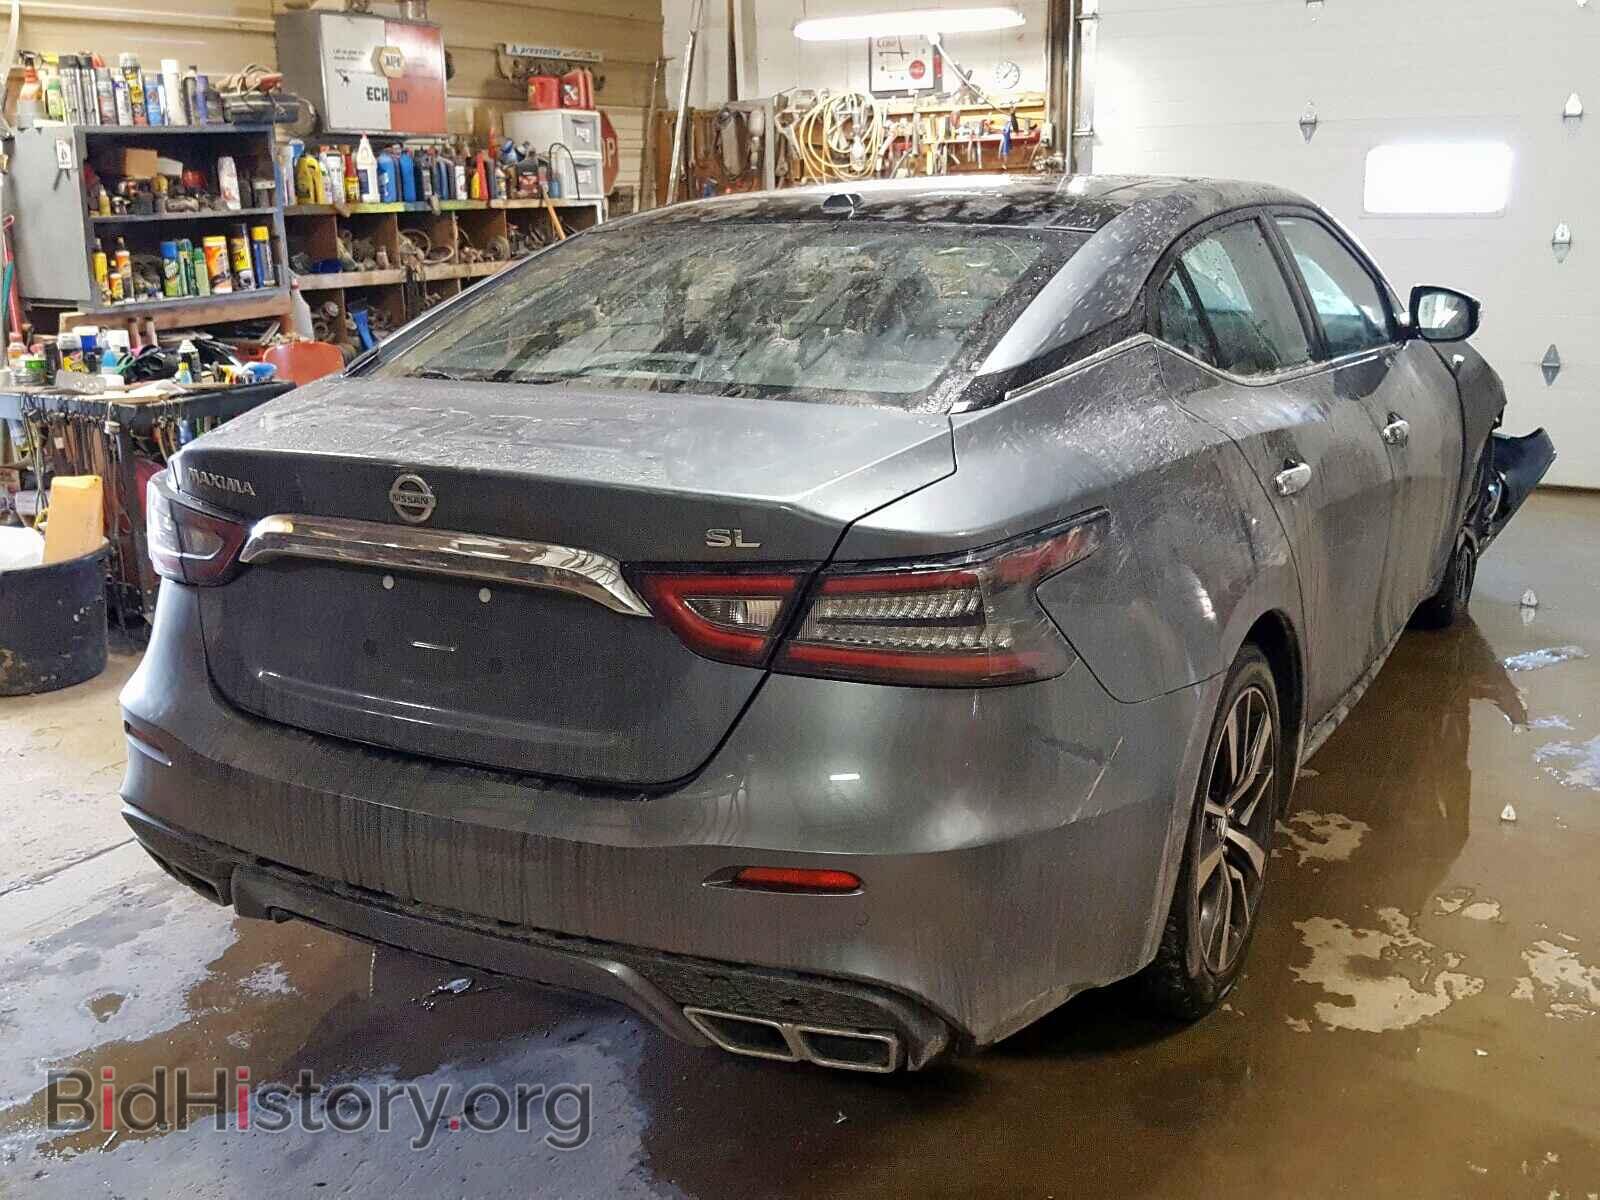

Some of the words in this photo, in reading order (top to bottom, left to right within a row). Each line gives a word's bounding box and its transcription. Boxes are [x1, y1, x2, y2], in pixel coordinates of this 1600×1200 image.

[188, 467, 256, 497] MAXIMA
[393, 495, 430, 505] NISSAN
[705, 528, 761, 548] SL
